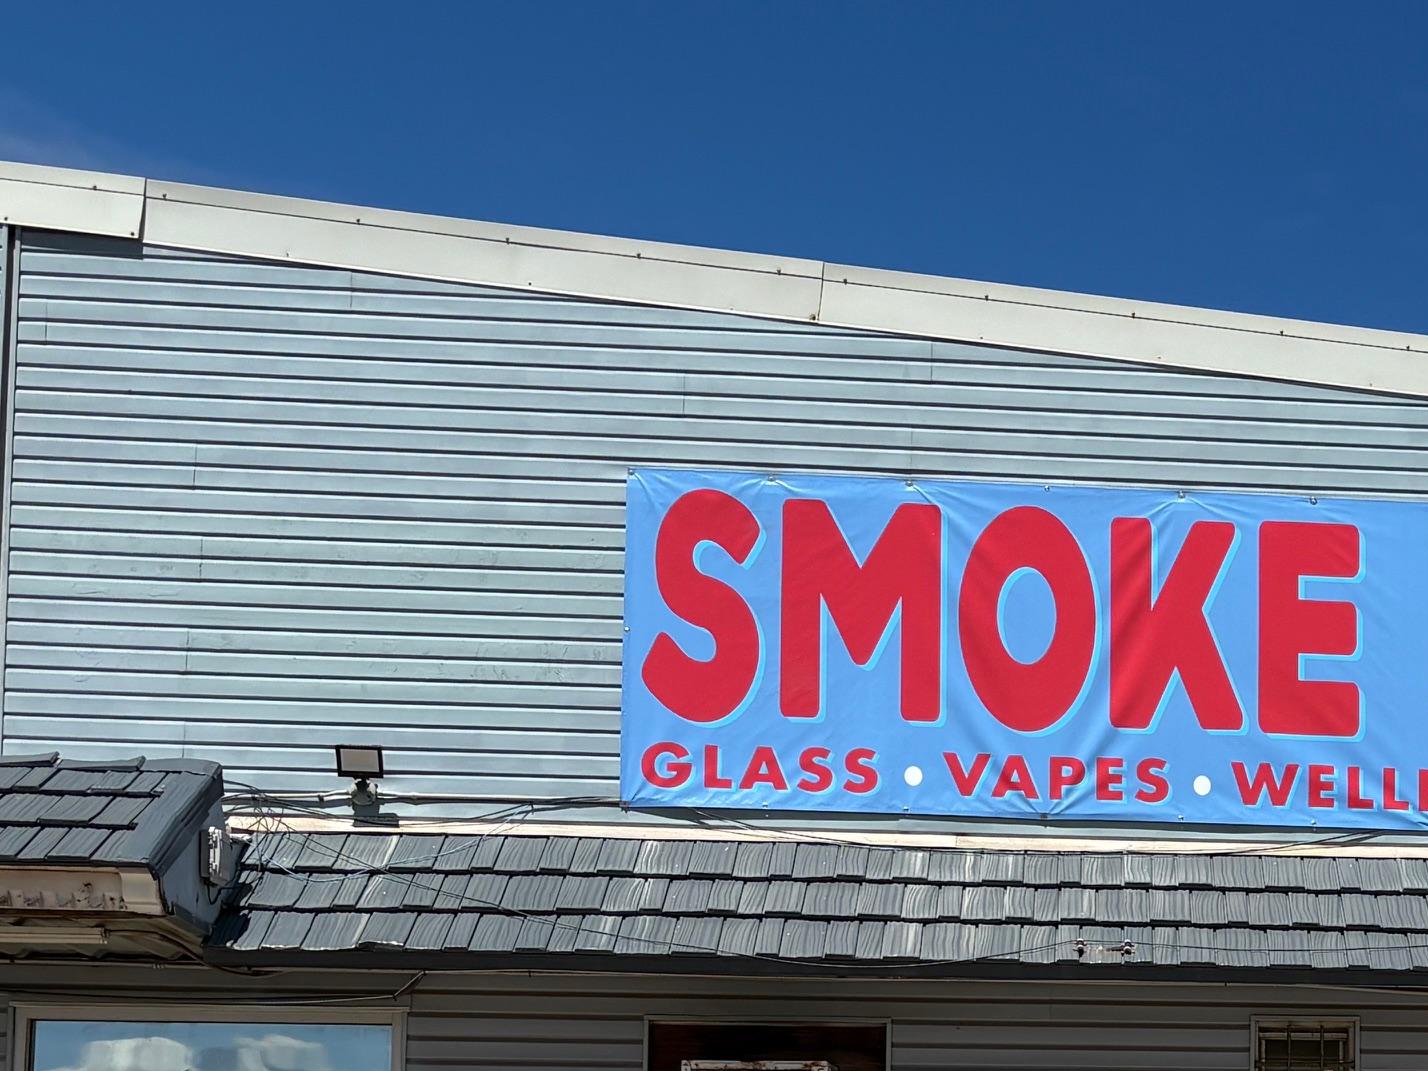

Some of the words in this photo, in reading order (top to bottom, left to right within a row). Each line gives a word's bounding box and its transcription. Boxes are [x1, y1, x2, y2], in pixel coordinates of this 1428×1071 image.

[642, 489, 1361, 736] SMOKE
[641, 742, 879, 793] GLASS
[944, 753, 1169, 802] VAPES
